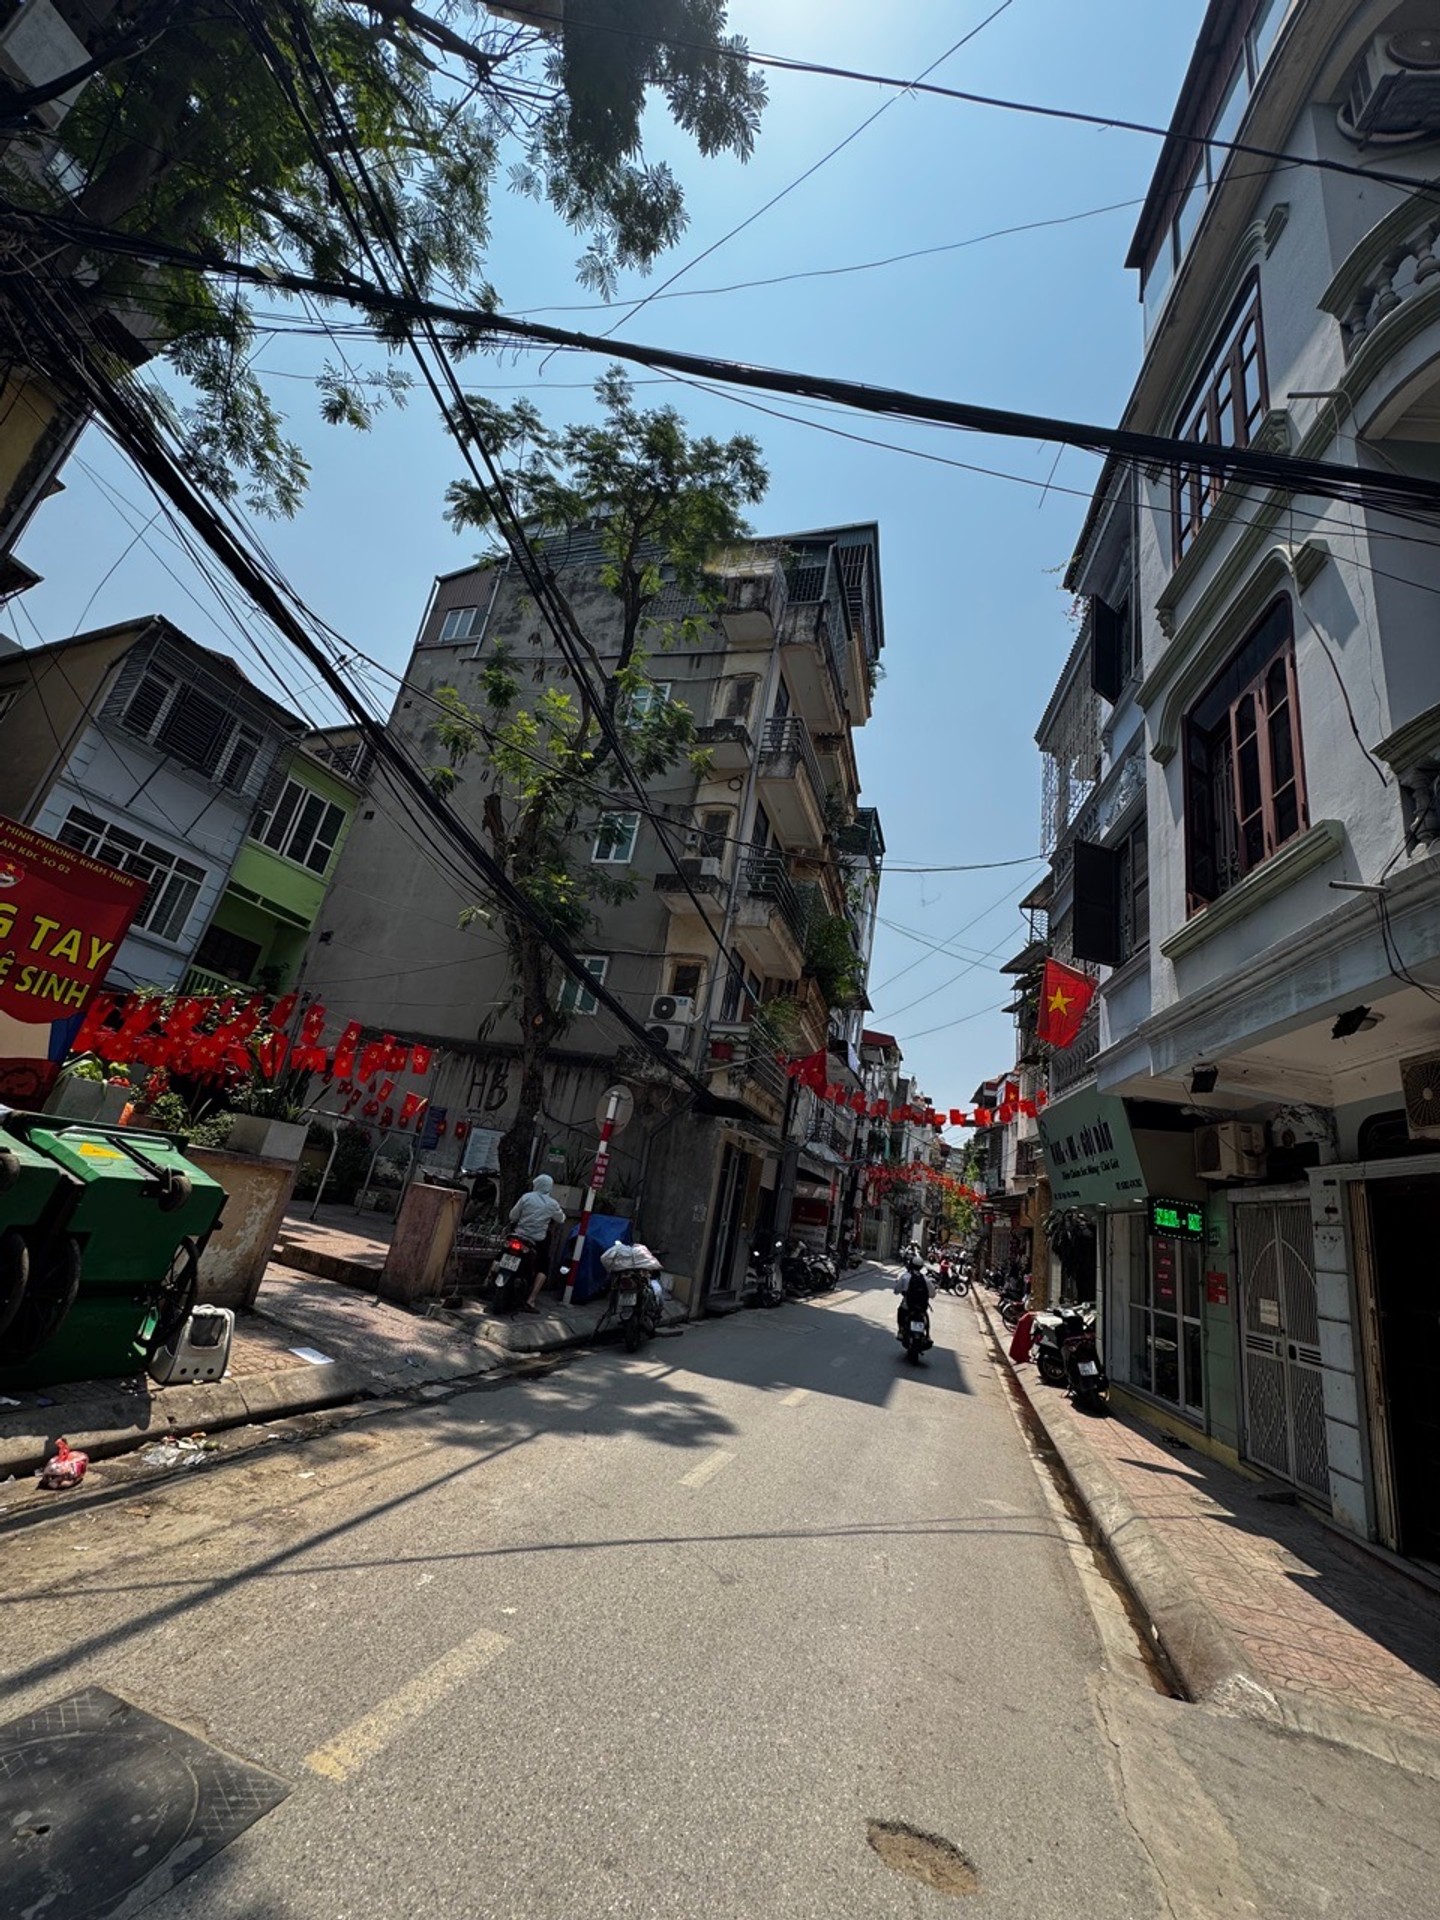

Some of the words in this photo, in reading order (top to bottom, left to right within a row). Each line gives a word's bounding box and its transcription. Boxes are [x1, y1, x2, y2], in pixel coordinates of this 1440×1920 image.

[6, 825, 34, 842] MINH
[30, 915, 113, 970] TAY
[15, 966, 90, 1008] SINH
